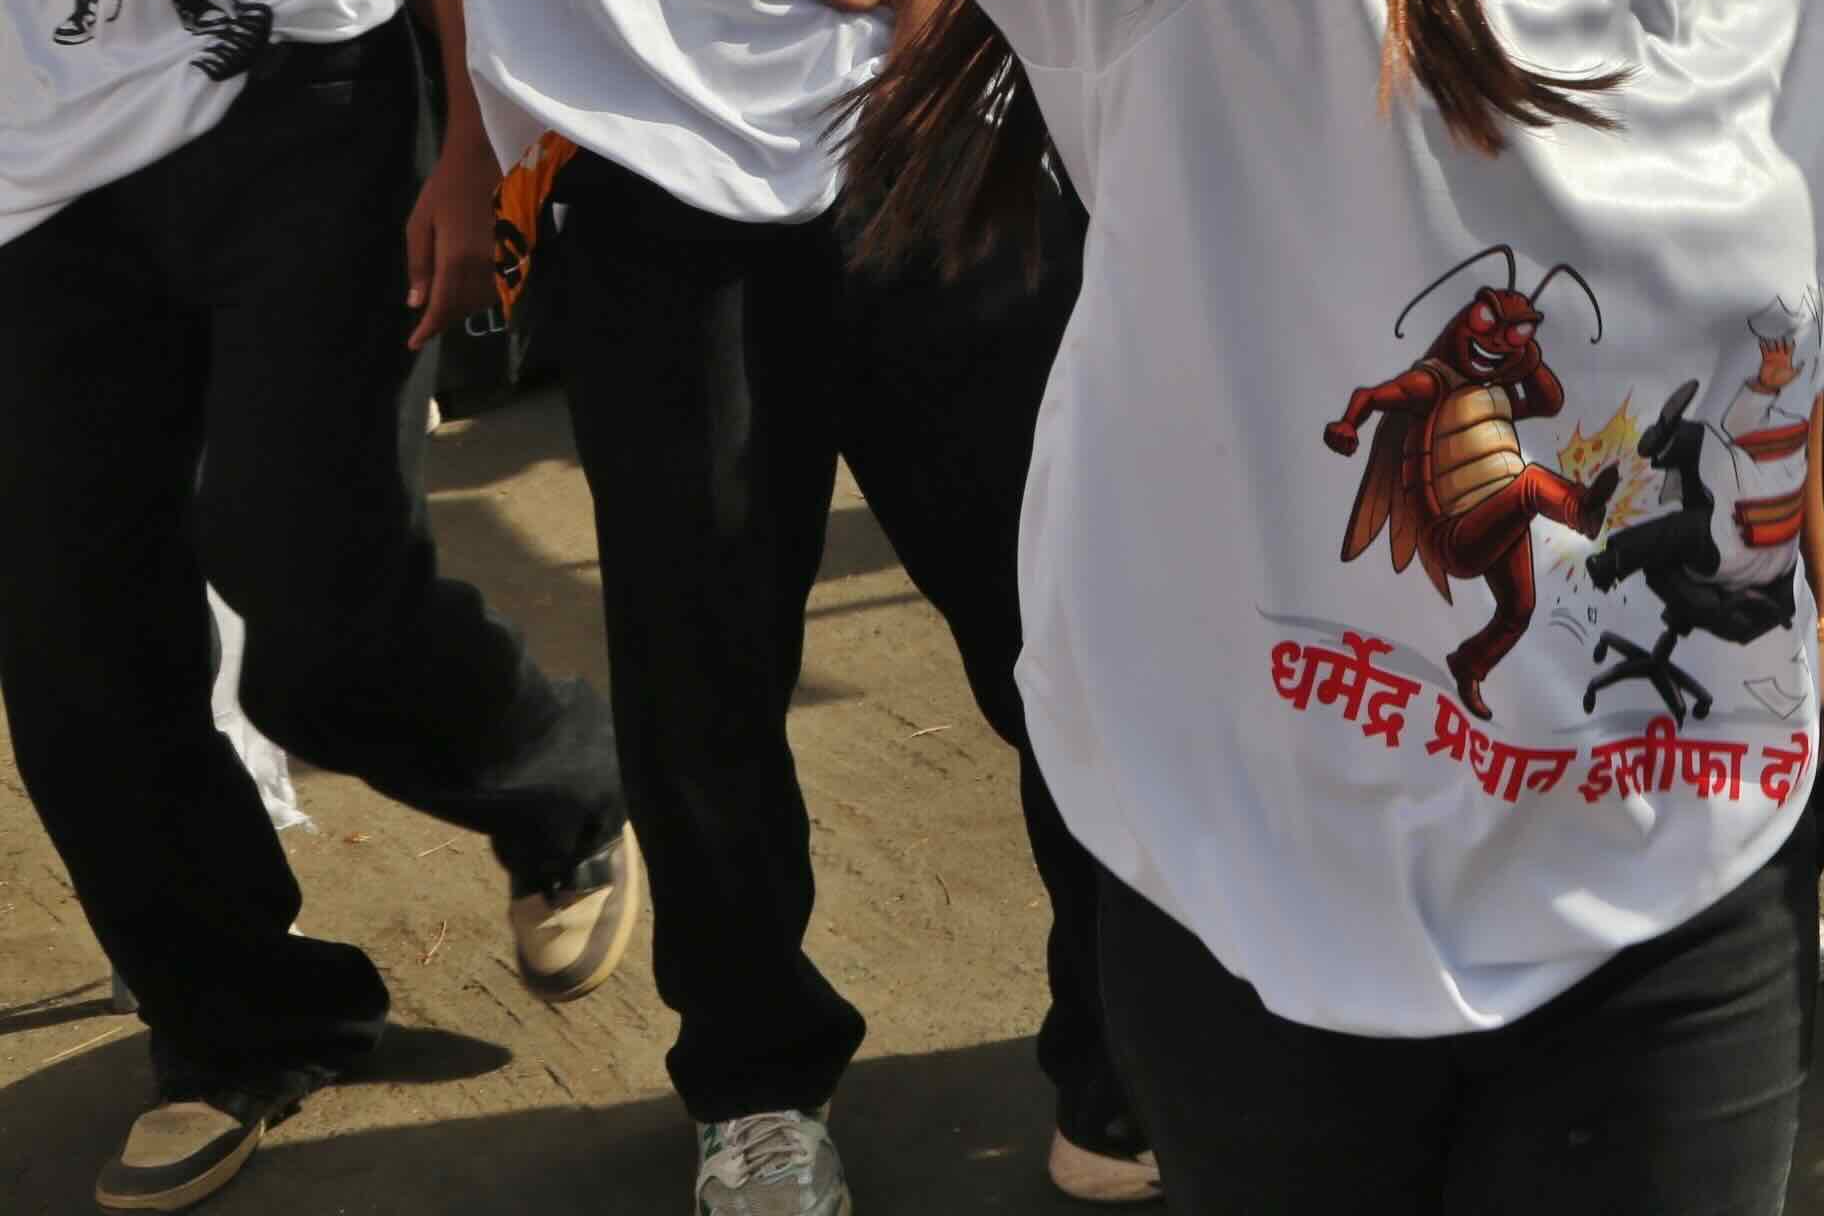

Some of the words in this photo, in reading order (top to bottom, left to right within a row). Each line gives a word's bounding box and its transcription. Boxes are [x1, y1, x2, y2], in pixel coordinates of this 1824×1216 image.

[1271, 631, 1422, 747] धर्मेंद्र
[1425, 692, 1576, 804] प्रधान
[1578, 716, 1747, 805] इस्तीफा
